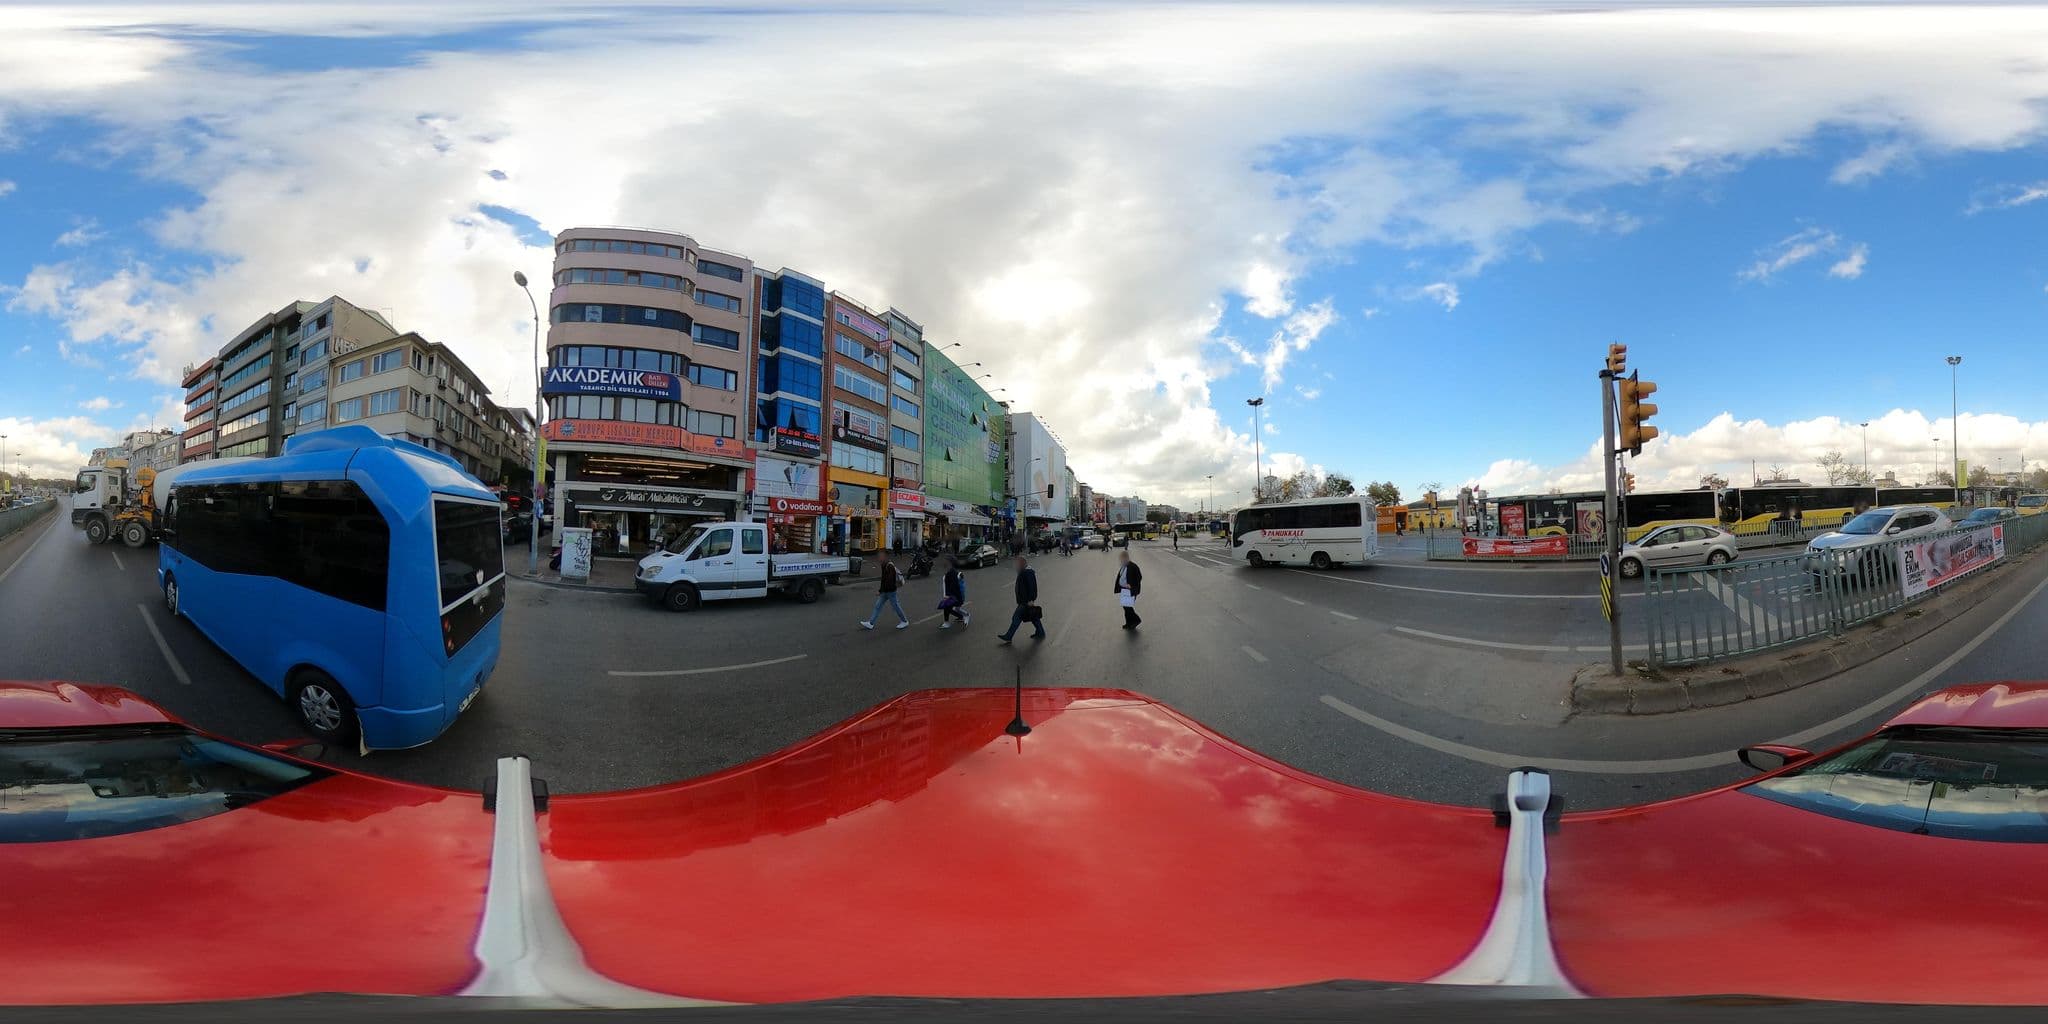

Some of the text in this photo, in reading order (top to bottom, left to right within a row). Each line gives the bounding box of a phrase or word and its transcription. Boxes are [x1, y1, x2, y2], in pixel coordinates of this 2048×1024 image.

[789, 502, 823, 512] vodafone
[1267, 529, 1305, 537] PAMUKKALE
[1904, 550, 1913, 564] 29
